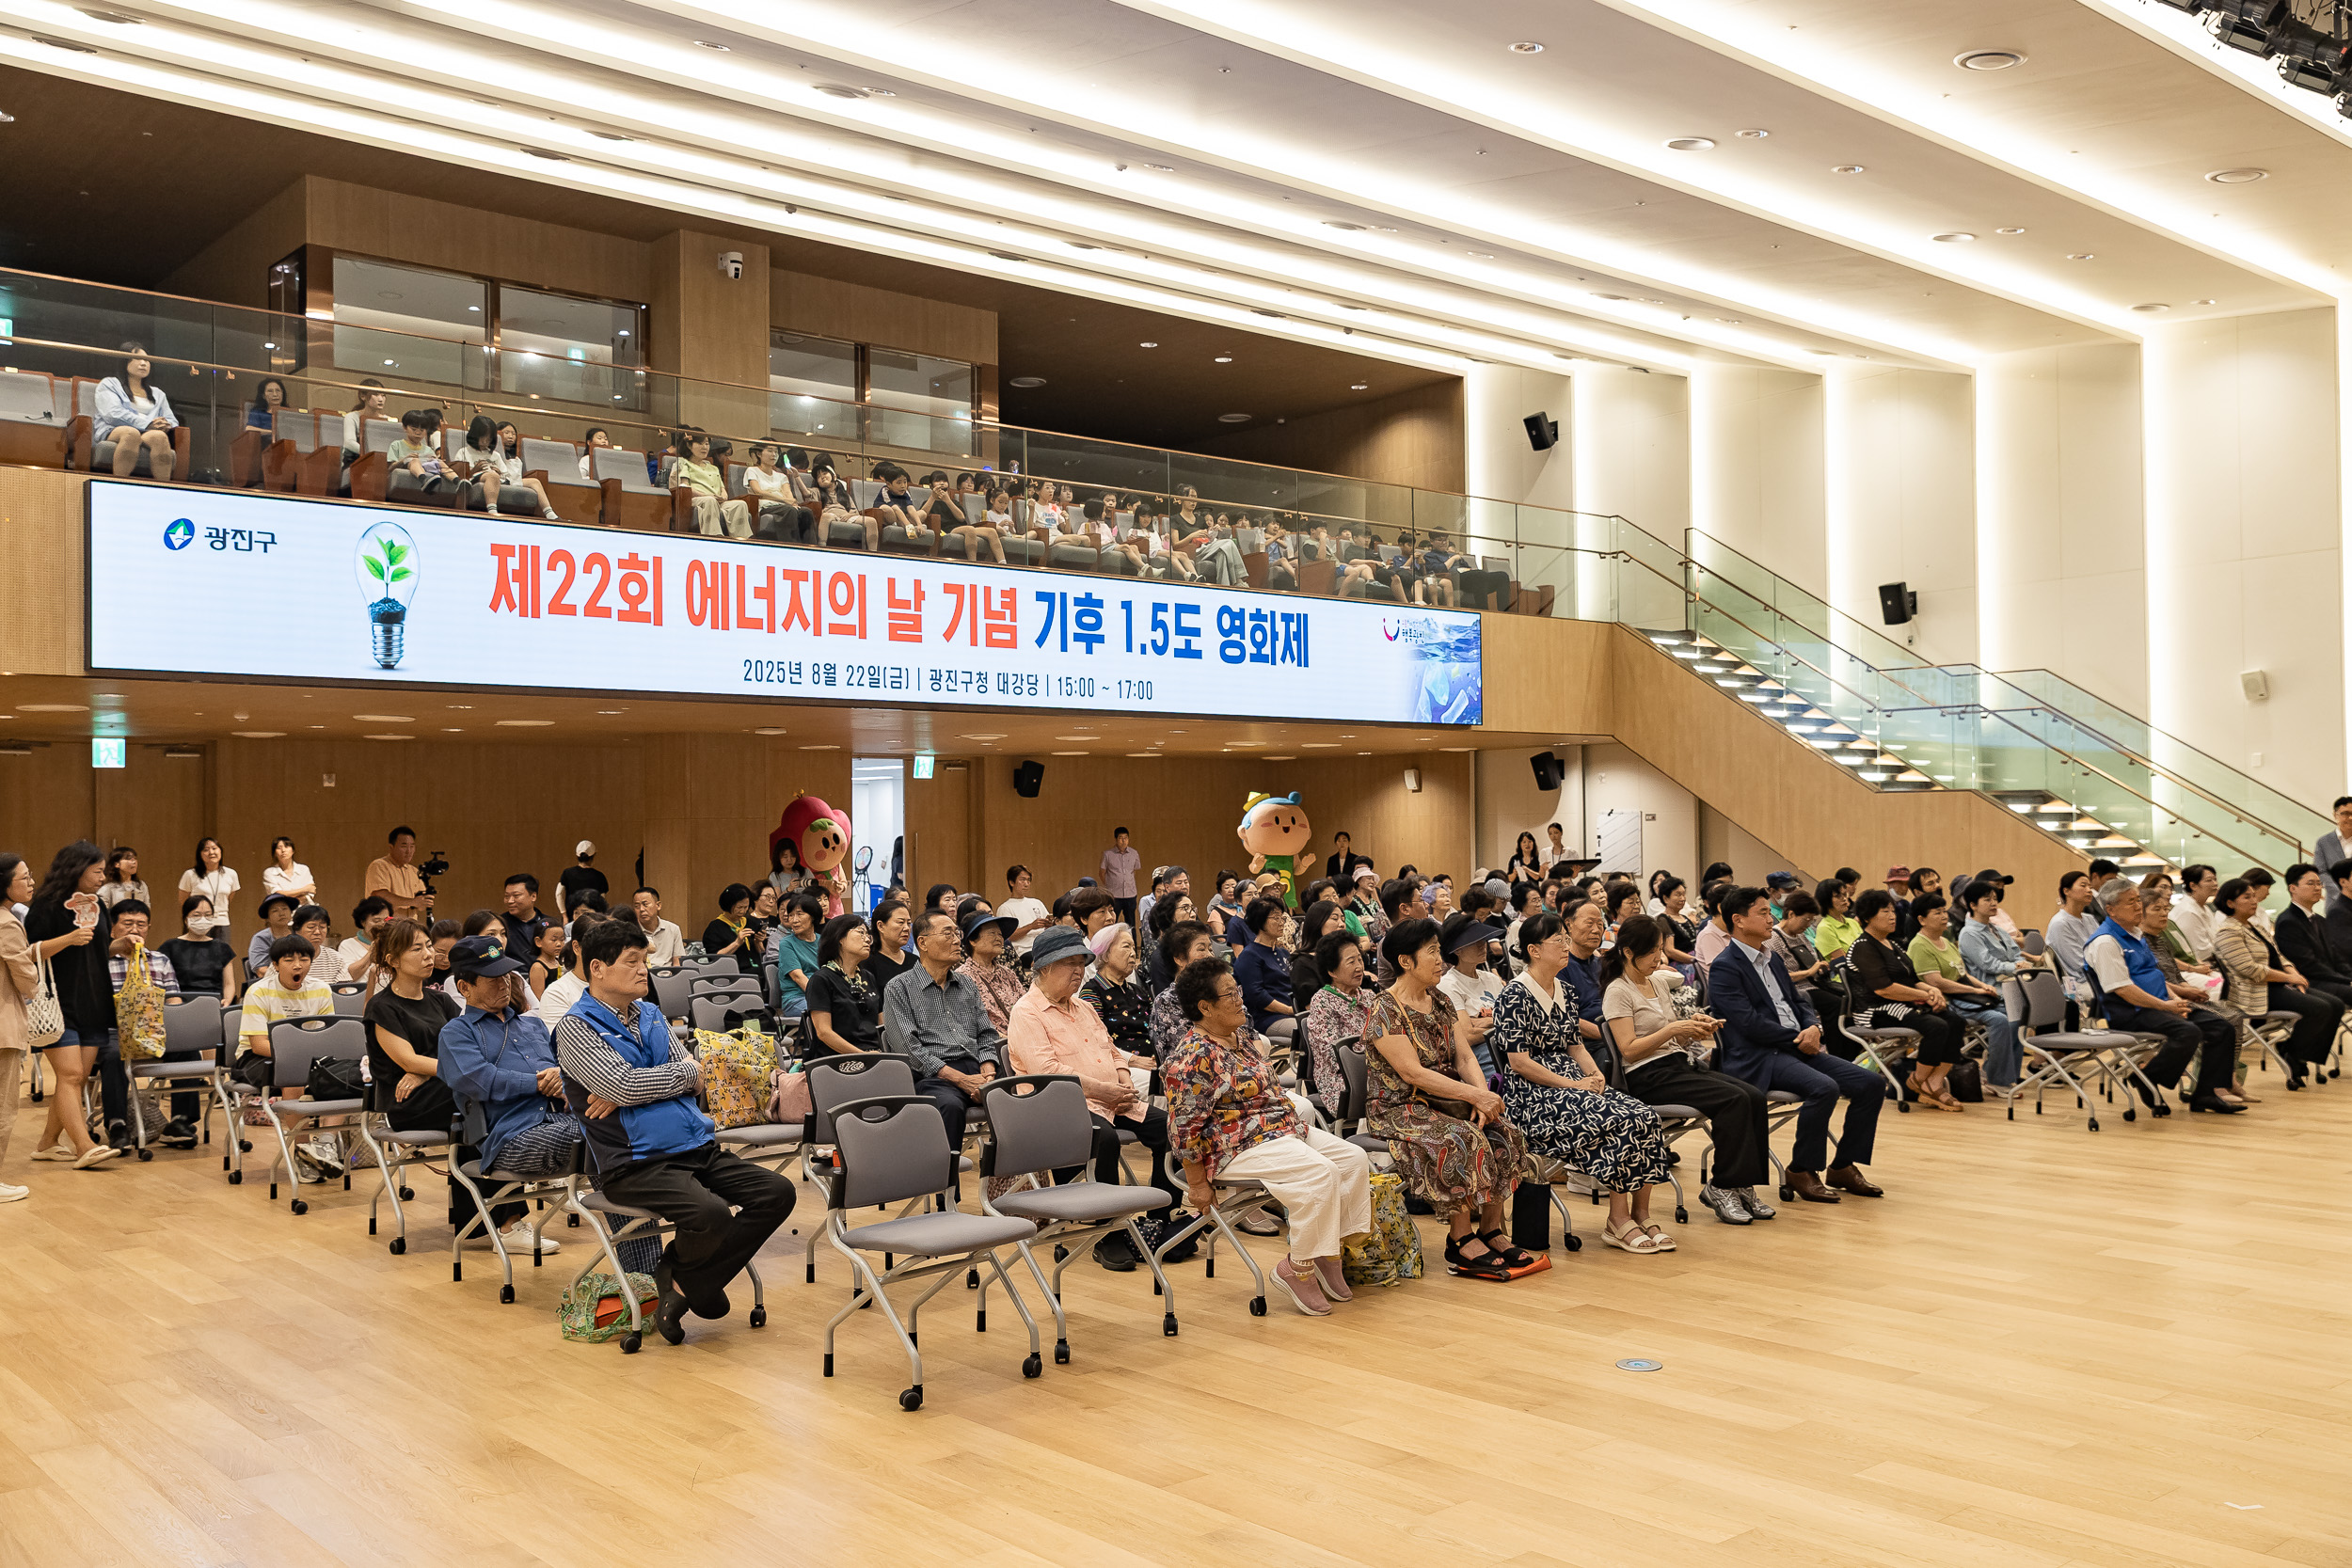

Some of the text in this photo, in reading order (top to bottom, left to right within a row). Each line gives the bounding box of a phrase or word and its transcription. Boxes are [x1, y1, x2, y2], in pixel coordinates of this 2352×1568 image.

[203, 526, 278, 554] 광진구
[488, 543, 1310, 669] 제22회 에너지의 날 기념 기후 1.5도 영화제
[743, 658, 803, 686] 2025년
[812, 662, 837, 687] 8월
[846, 664, 910, 690] 22일(금)
[929, 668, 989, 694] 광진구청
[996, 672, 1040, 697] 대강당
[1057, 675, 1095, 698] 15:00
[1117, 679, 1153, 701] 17:00
